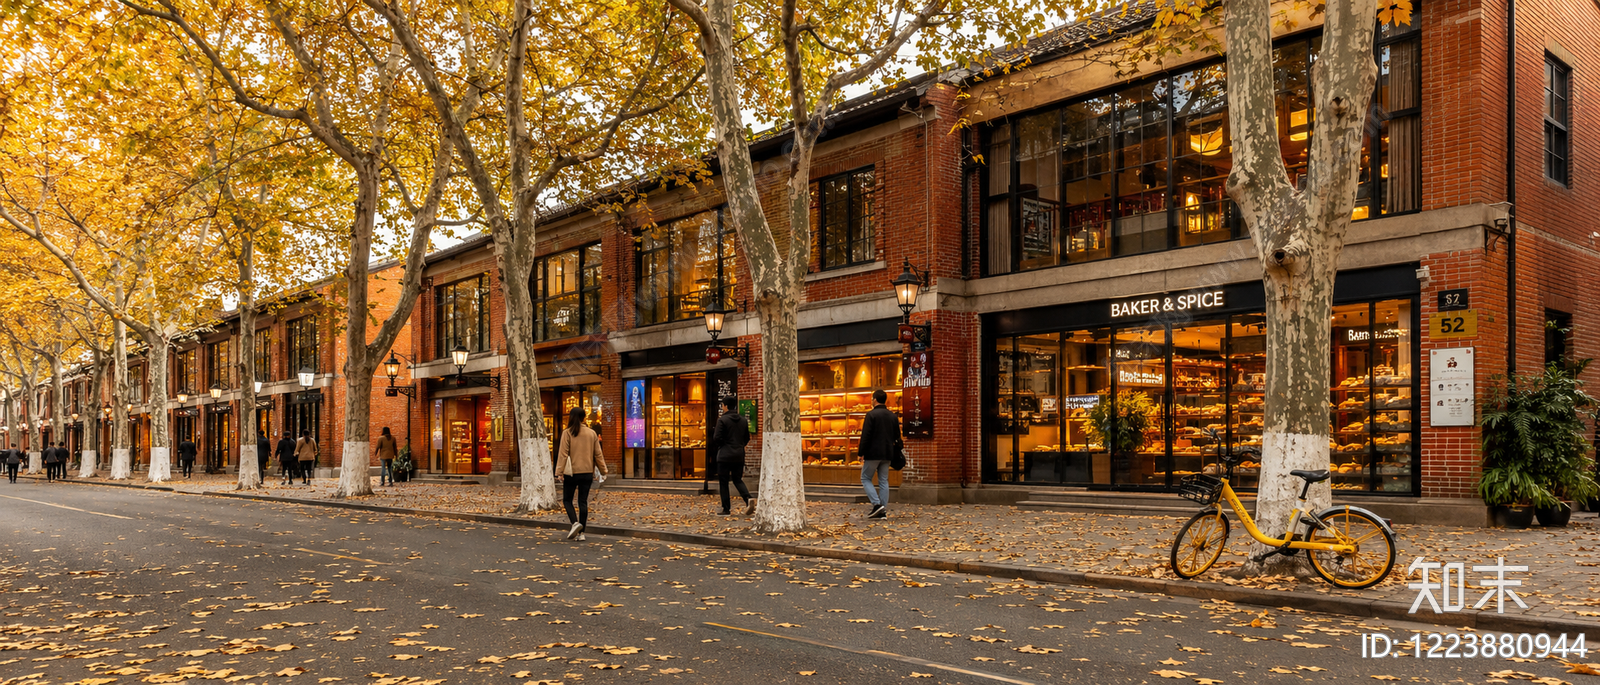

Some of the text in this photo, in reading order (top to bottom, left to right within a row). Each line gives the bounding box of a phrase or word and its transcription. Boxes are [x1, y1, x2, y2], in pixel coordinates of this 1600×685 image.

[1110, 291, 1225, 317] BAKER & SPICE
[1440, 316, 1466, 334] 52
